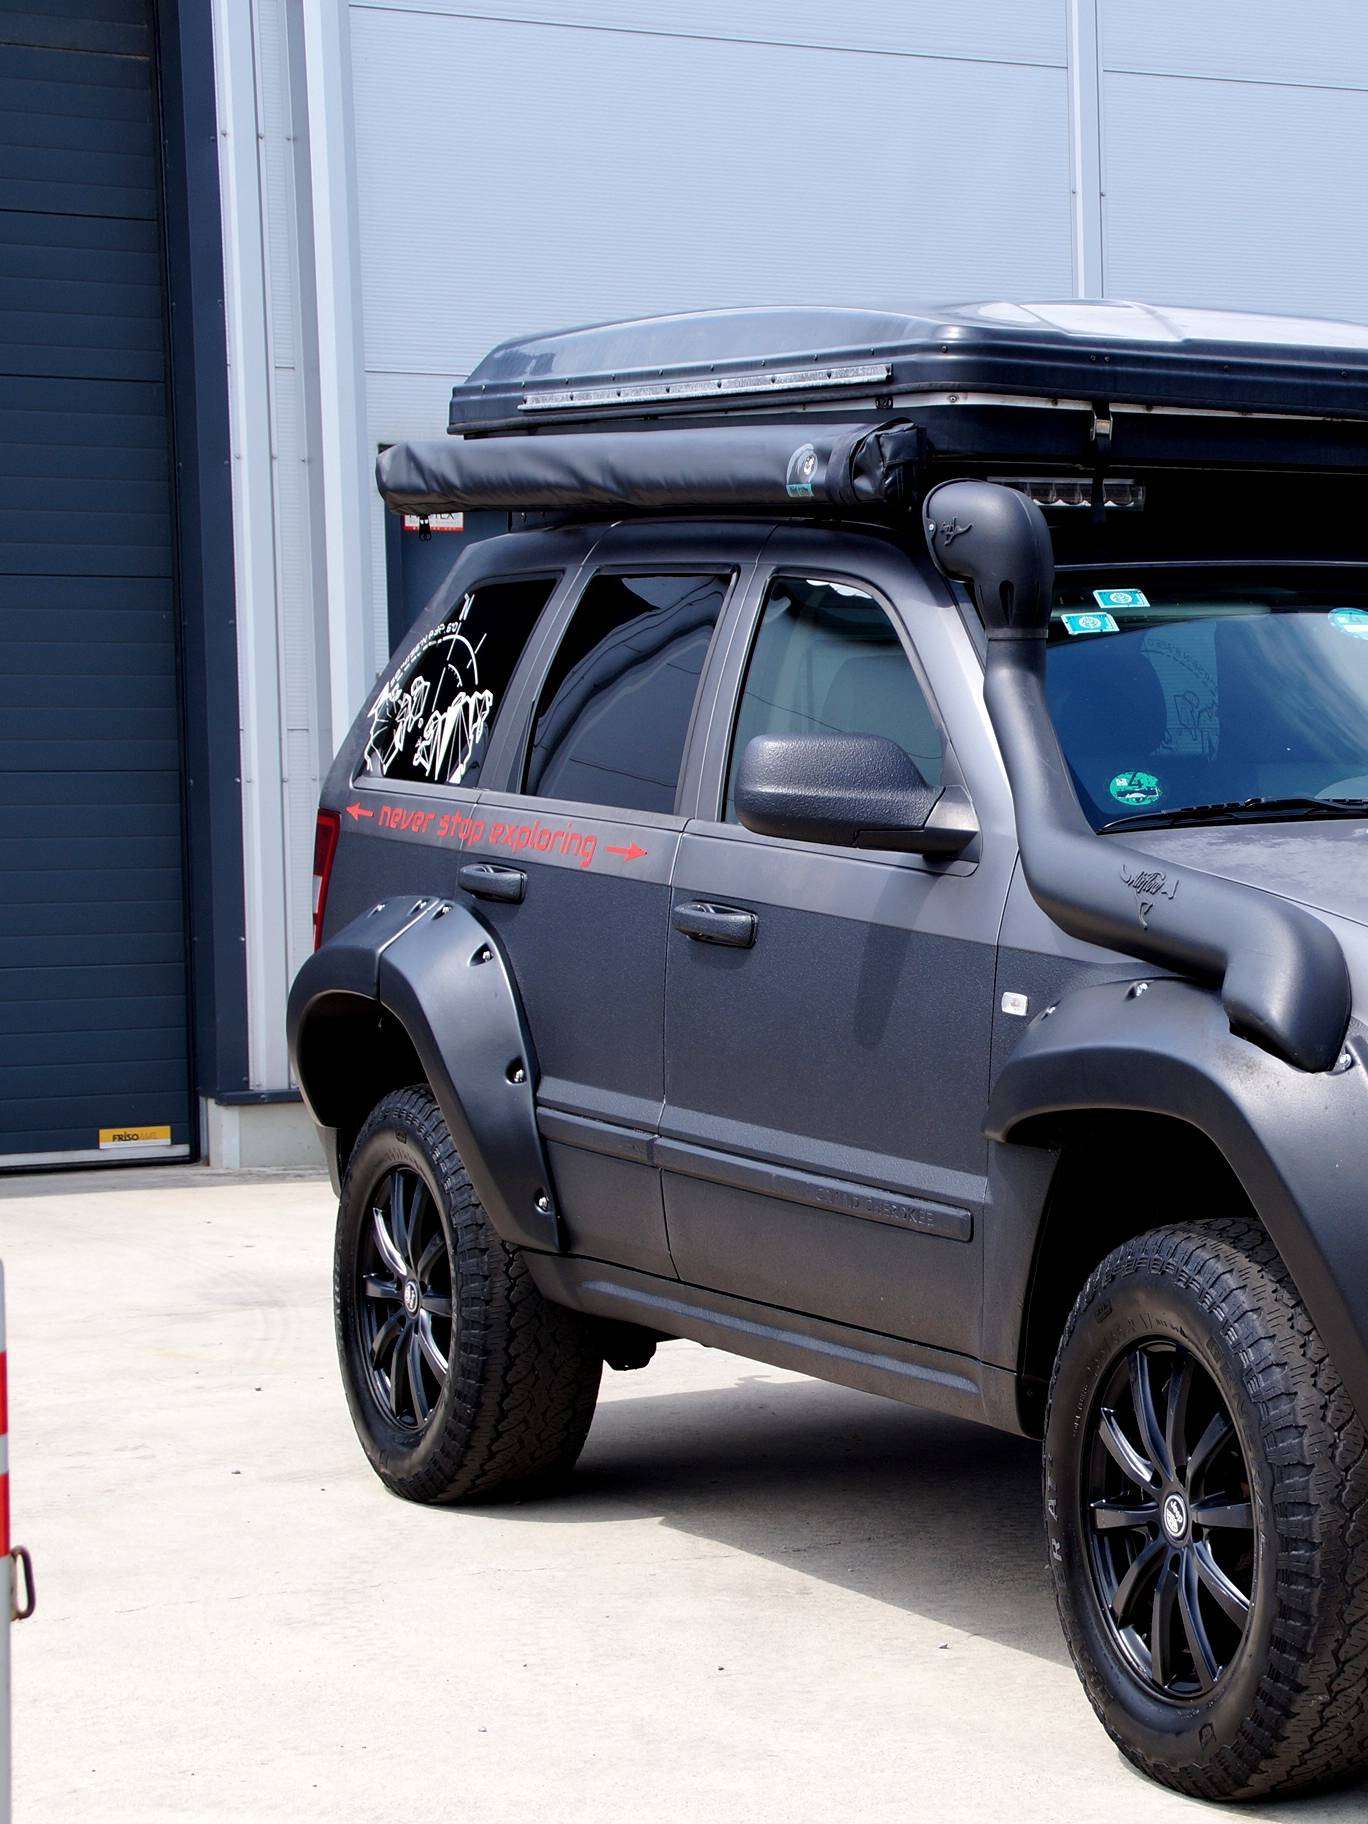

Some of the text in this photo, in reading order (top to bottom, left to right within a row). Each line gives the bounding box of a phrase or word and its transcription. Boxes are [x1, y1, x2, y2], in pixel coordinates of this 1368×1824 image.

[378, 804, 598, 868] never stop exploring
